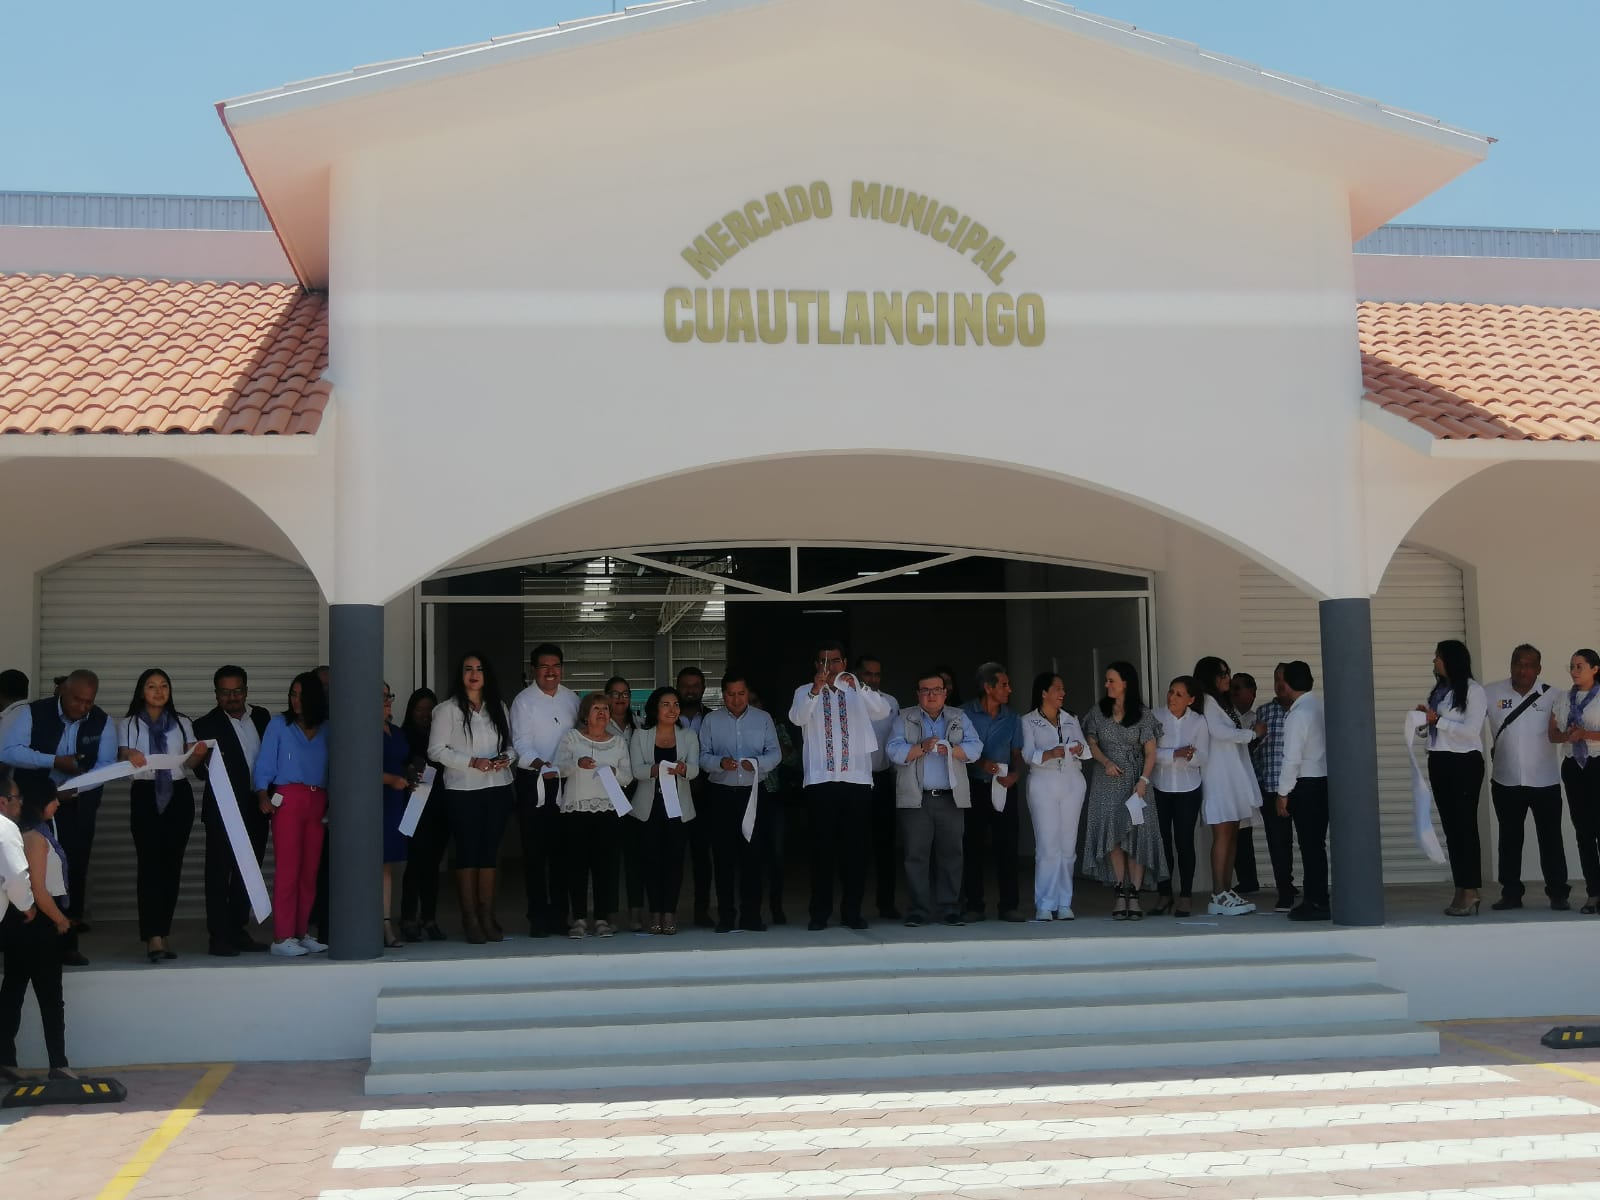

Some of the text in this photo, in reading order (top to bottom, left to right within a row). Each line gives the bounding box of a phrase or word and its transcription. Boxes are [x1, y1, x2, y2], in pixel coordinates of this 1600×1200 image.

[681, 181, 1016, 285] MERCADO MUNICIPAL
[664, 287, 1046, 347] CUAUTLANCINGO
